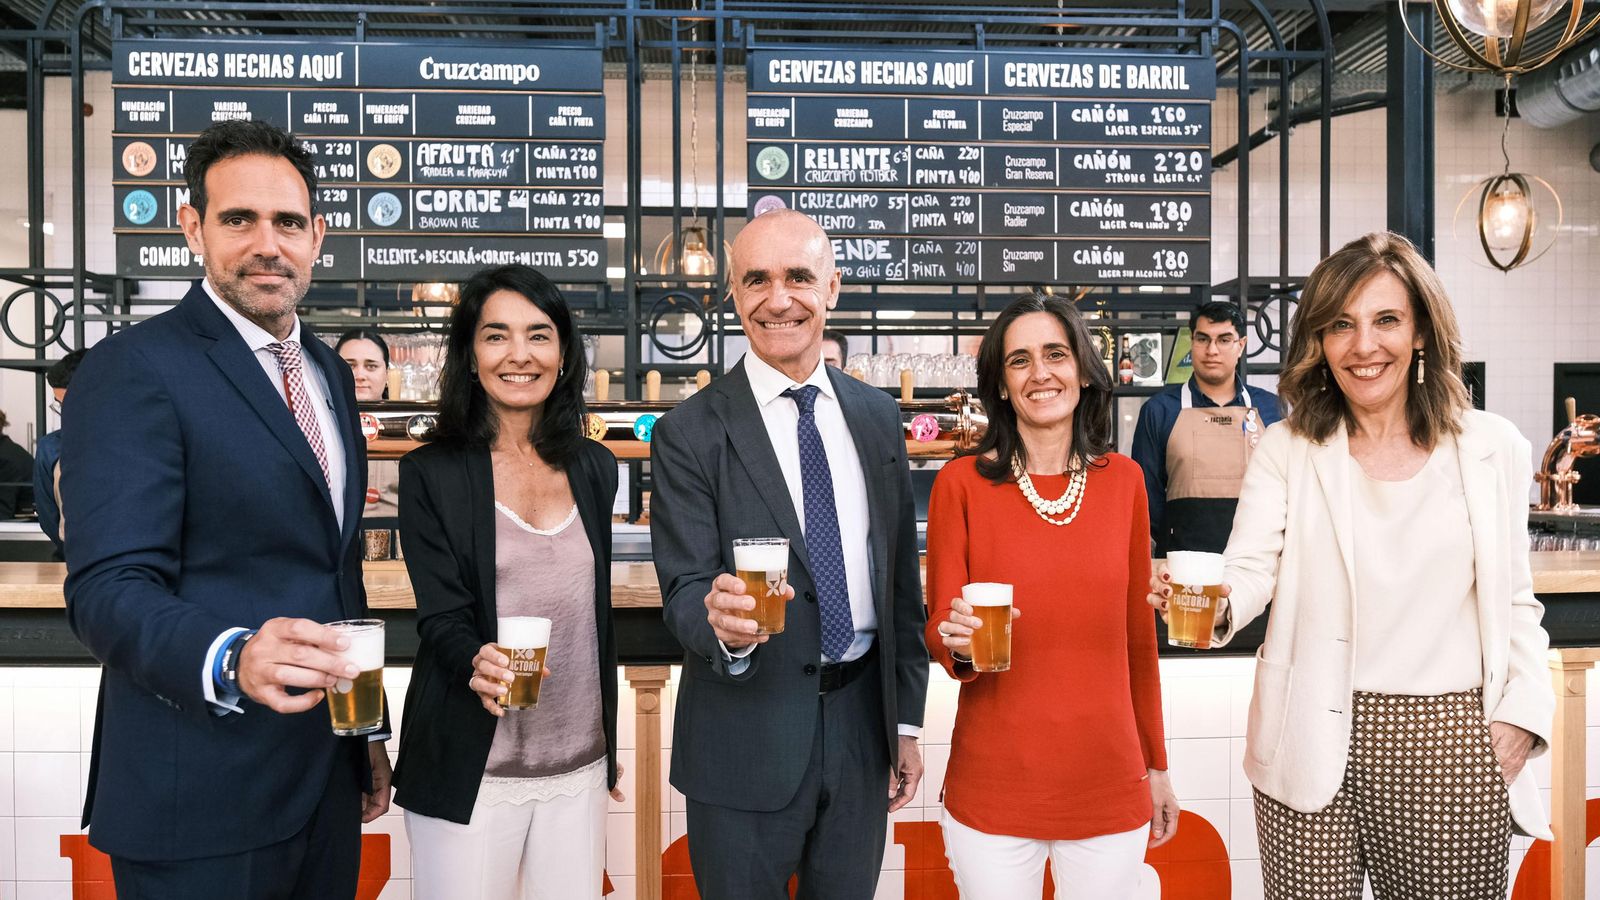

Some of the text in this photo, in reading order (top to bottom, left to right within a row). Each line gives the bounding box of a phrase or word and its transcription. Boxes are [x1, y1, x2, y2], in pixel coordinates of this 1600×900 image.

[129, 51, 343, 81] CERVEZAS HECHAS AQUÍ
[420, 57, 540, 84] Cruzcampo
[769, 59, 974, 89] CERVEZAS HECHAS AQUÍ
[1004, 62, 1189, 90] CERVEZAS DE BARRIL
[214, 102, 247, 112] VARIEDAD
[313, 102, 337, 113] PRECIO
[458, 105, 491, 115] VARIEDAD
[558, 106, 582, 116] PRECIO
[837, 108, 868, 118] VARIEDAD
[1071, 104, 1129, 123] CAÑÓN
[140, 112, 160, 121] GRIFO
[212, 112, 251, 122] CRUZCAMPO
[304, 113, 349, 124] CAÑA PINTA
[384, 114, 404, 124] GRIFO
[456, 115, 496, 125] CRUZCAMPO
[933, 109, 956, 119] PRECIO
[1003, 108, 1043, 120] Cruzcampo
[549, 116, 593, 127] CAÑA PINTA
[834, 118, 873, 128] CRUZCAMPO
[947, 120, 967, 130] PINTA
[1003, 120, 1032, 133] Especial
[1105, 125, 1138, 136] LAGER
[1141, 125, 1182, 136] ESPECIAL
[416, 142, 494, 168] AFRUTÁ
[533, 145, 567, 160] CAÑA
[804, 148, 891, 170] RELENTE
[915, 146, 945, 160] CAÑA
[1005, 155, 1046, 168] Cruzcampo
[1073, 149, 1203, 172] CAÑÓN 2'20
[420, 166, 454, 178] RADLER
[536, 166, 572, 180] PINTA
[916, 169, 956, 184] PINTA
[1005, 168, 1053, 180] Gran Reserva
[1105, 173, 1146, 183] STRONG
[1153, 173, 1184, 184] LAGER
[416, 189, 502, 213] CORAJE
[533, 190, 566, 205] CAÑA
[799, 192, 878, 209] CRUZCAMPO
[911, 194, 940, 207] CAÑA
[1004, 203, 1045, 216] Cruzcampo
[1070, 198, 1192, 222] CAÑÓN 1'80
[419, 216, 480, 229] BROWN ALE
[533, 216, 570, 230] PINTA
[807, 214, 886, 230] ALENTO IPA
[911, 213, 947, 228] PINTA
[1004, 215, 1028, 227] Radler
[1100, 220, 1127, 230] LAGER
[1129, 221, 1144, 229] CON
[832, 239, 892, 260] ENDE
[912, 241, 943, 254] CAÑA
[140, 246, 189, 267] COMBO
[567, 248, 599, 267] 5'50
[1003, 248, 1044, 261] Cruzcampo
[1073, 246, 1189, 270] CAÑÓN 1'80
[1003, 260, 1015, 273] Sin
[1098, 269, 1121, 278] LAGER
[1135, 270, 1167, 278] ALCOHOL
[1173, 594, 1210, 609] FACTORÍA
[509, 660, 540, 671] ACTORÍA
